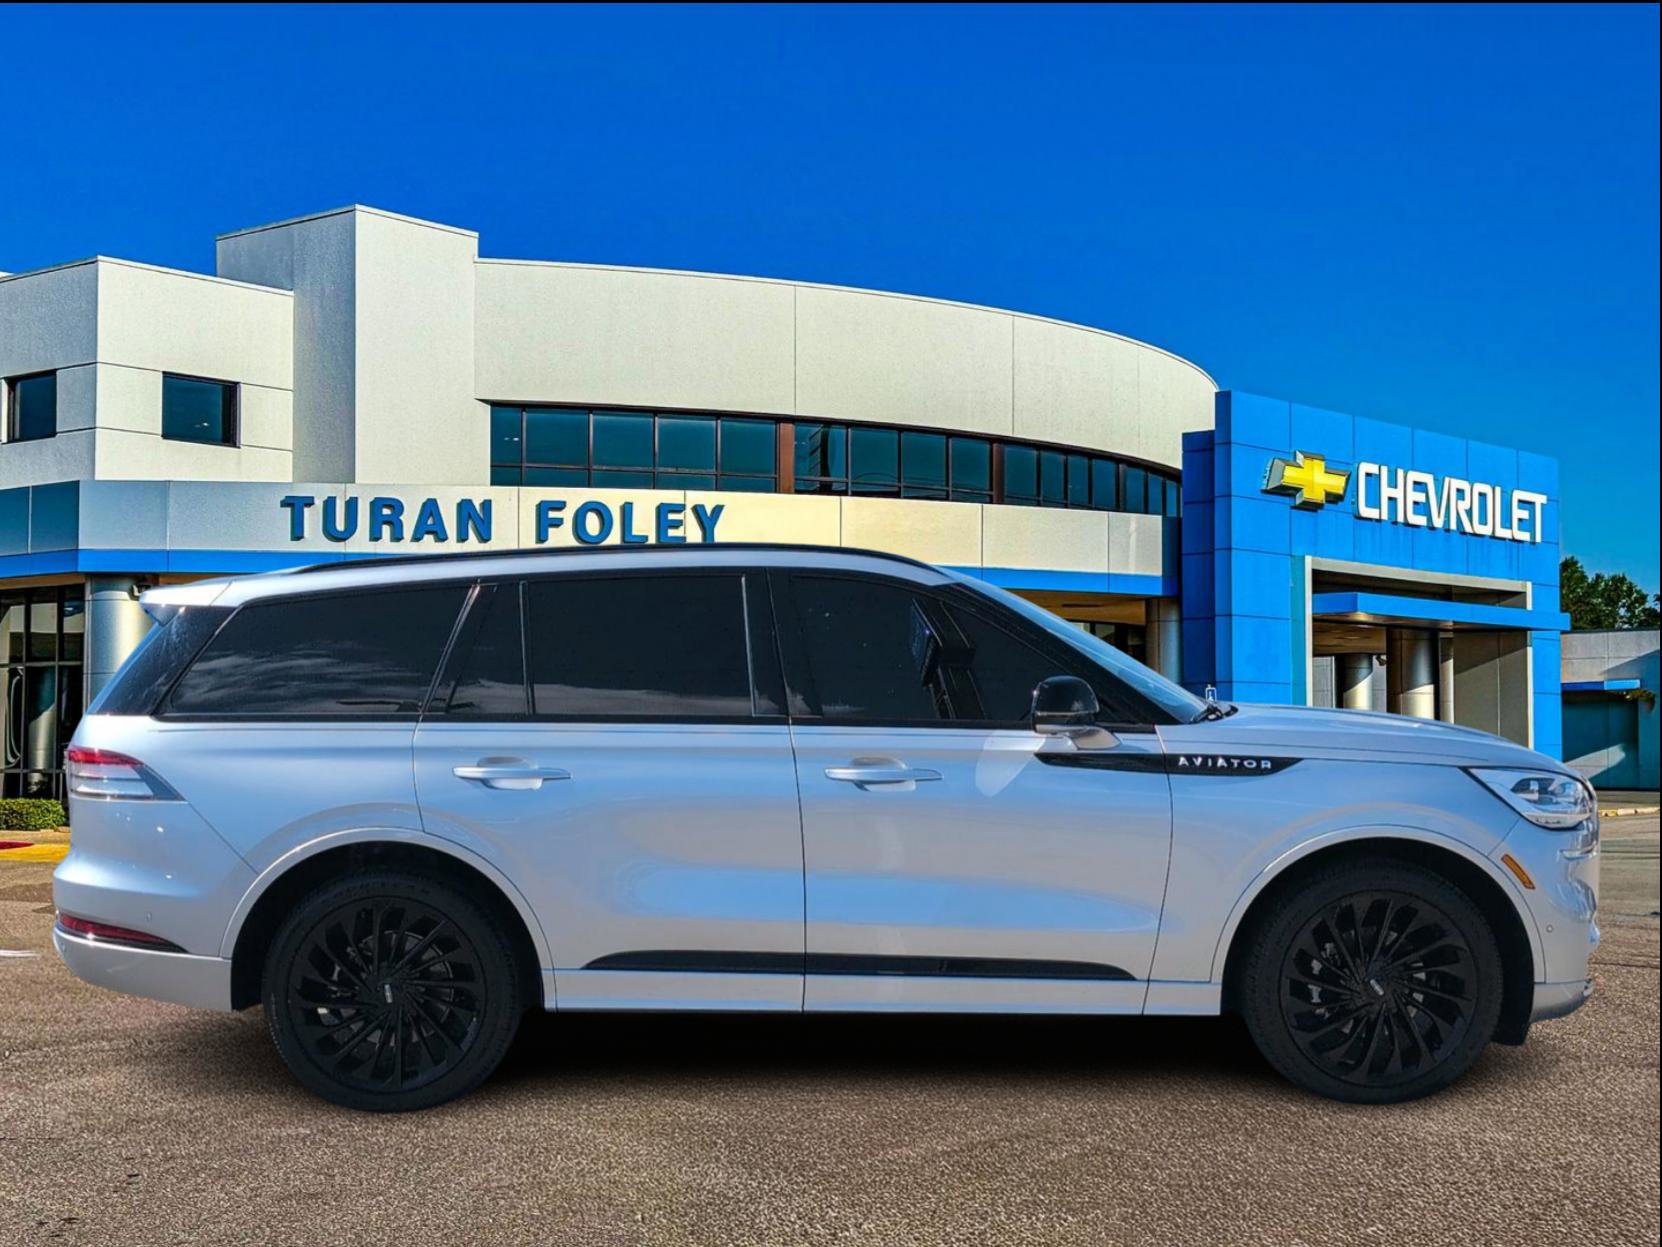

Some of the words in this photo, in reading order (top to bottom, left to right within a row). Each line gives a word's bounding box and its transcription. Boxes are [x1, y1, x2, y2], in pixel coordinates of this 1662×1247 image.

[280, 496, 492, 543] TURAN
[535, 500, 725, 544] FOLEY
[1356, 461, 1547, 543] CHEVROLET
[1178, 756, 1272, 769] AVIATOR
